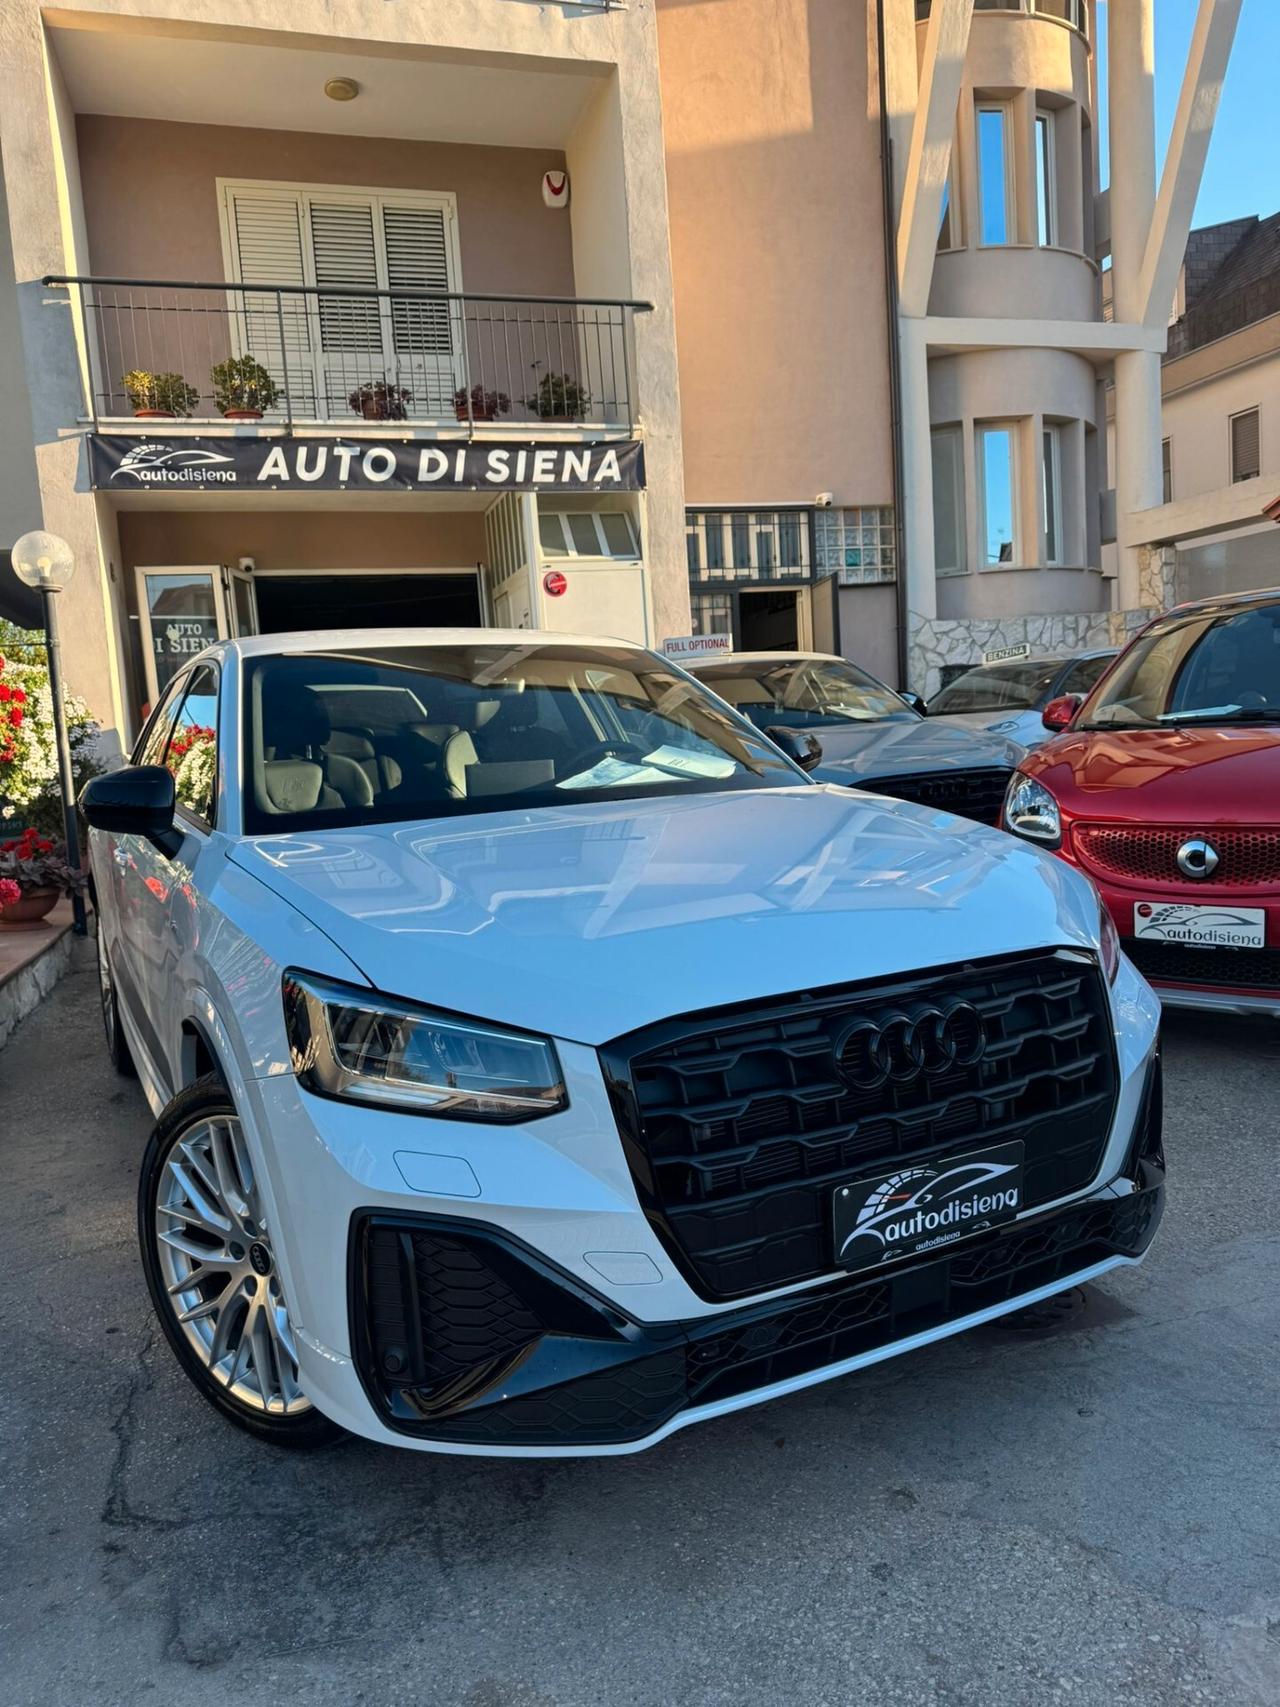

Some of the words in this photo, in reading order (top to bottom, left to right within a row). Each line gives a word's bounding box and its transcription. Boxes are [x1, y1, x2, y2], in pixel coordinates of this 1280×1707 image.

[257, 446, 397, 482] AUTO
[418, 448, 466, 482] DI
[485, 449, 622, 483] SIENA
[141, 467, 237, 483] autodisiena
[166, 623, 202, 635] AUTO
[666, 641, 688, 653] FULL
[688, 638, 730, 651] OPTIONAL
[987, 646, 1025, 660] BENZINA
[1167, 928, 1262, 946] autodisiena
[885, 1187, 1018, 1242] autodisiena
